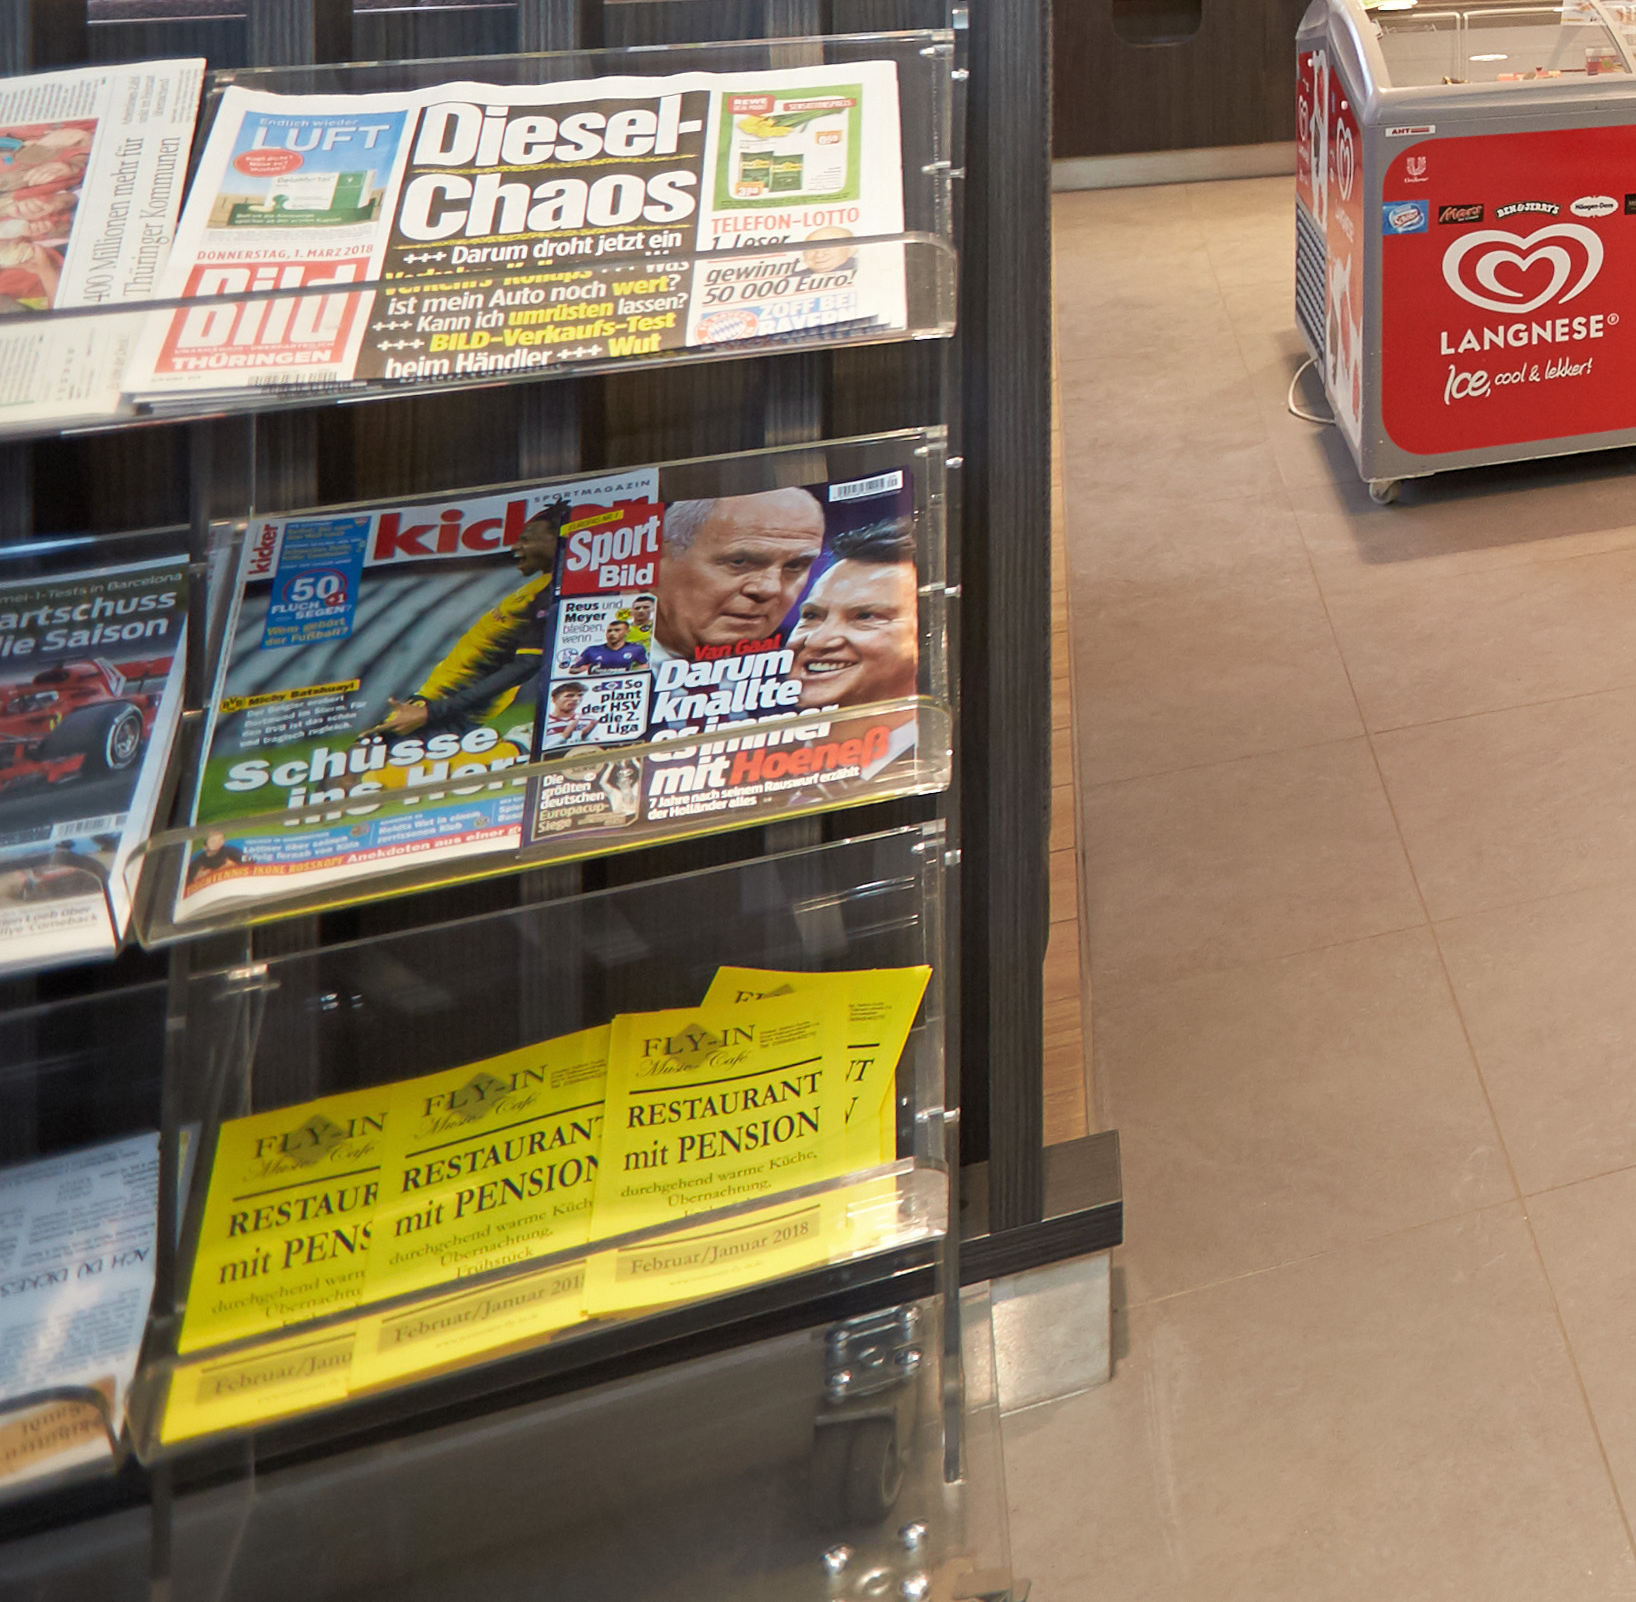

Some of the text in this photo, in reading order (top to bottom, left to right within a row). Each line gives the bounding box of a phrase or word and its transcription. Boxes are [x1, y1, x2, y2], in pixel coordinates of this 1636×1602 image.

[251, 124, 391, 152] LUFT
[413, 94, 702, 166] Diesel-
[399, 170, 698, 241] Chaos
[711, 207, 860, 235] TELEFON-LOTTO
[1439, 205, 1482, 224] Mars
[197, 249, 291, 261] DONNERSTAG,
[344, 244, 374, 256] 2018
[451, 230, 682, 265] Darum droht jetzt ein
[702, 268, 859, 305] 50 000 Euro!
[704, 258, 802, 286] gewinnt
[387, 296, 418, 316] ist
[422, 292, 484, 315] mein
[488, 286, 546, 309] Auto
[550, 280, 607, 303] noch
[612, 274, 683, 297] wert?
[416, 292, 690, 334] Kann ich umrüsten lassen?
[429, 312, 677, 354] BILD-Verkaufs-Test
[1440, 313, 1604, 355] LANGNESE
[171, 349, 332, 371] THÜRINGEN
[385, 332, 661, 379] beim Händler Wut
[1494, 362, 1527, 386] cool
[1529, 365, 1541, 383] &
[1545, 356, 1594, 381] lekker!
[534, 480, 651, 503] SPORTMAGAZIN
[252, 523, 279, 573] kicker
[567, 515, 660, 572] Sport
[291, 574, 340, 602] 50
[598, 562, 655, 588] Bild
[271, 601, 320, 615] FLUCH
[564, 611, 607, 624] Meyer
[565, 599, 623, 613] Reus und
[40, 614, 169, 654] Saison
[695, 633, 782, 661] Van Gaal
[624, 679, 643, 690] So
[653, 649, 795, 693] Darum
[581, 699, 641, 715] der HSV
[601, 690, 642, 704] plant
[650, 678, 803, 725] knallte
[599, 710, 640, 724] die 2.
[607, 724, 639, 735] Liga
[224, 726, 498, 792] Schüsse
[649, 755, 731, 796] mit
[728, 725, 892, 786] Hoeneß
[540, 790, 605, 810] deutschen
[657, 765, 860, 808] Jahre nach seinem Rauswurf erzählt
[648, 795, 758, 821] der Holländer alles
[346, 839, 430, 865] Anekdoten
[434, 835, 462, 849] aus
[642, 1023, 757, 1060] FLY-IN
[627, 1069, 824, 1131] RESTAURANT
[622, 1104, 821, 1173] mit PENSION
[620, 1149, 819, 1198] durchgehend warme Küche,
[667, 1179, 772, 1209] Übernachtung,
[388, 1224, 493, 1266] durchgehend
[630, 1220, 810, 1276] Februar/Januar 2018
